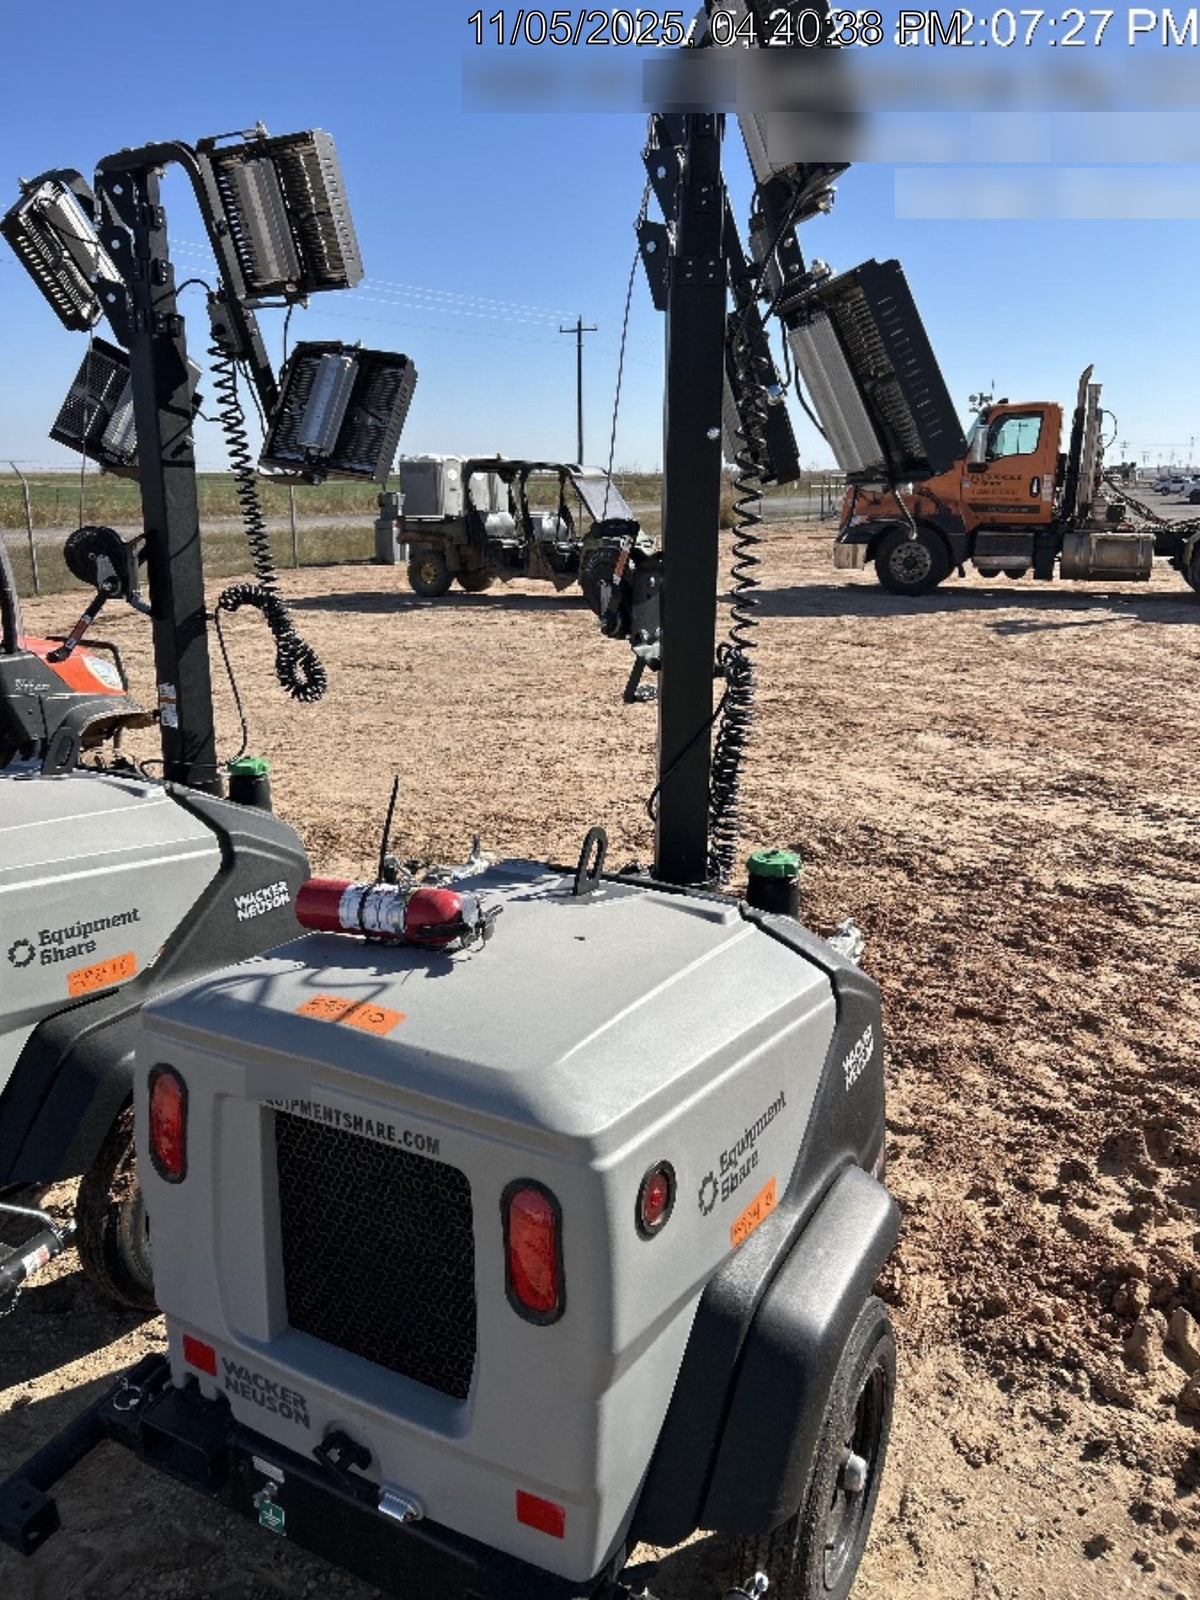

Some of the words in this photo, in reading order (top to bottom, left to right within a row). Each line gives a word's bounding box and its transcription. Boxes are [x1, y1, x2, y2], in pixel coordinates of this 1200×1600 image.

[38, 907, 141, 946] Equipment
[39, 939, 97, 966] Share
[257, 1098, 441, 1156] UIPMENTSHARE.COM
[719, 1090, 787, 1177] Equipment
[721, 1149, 760, 1203] Share
[221, 1357, 309, 1415] WACKER
[224, 1375, 311, 1431] NEUSON
